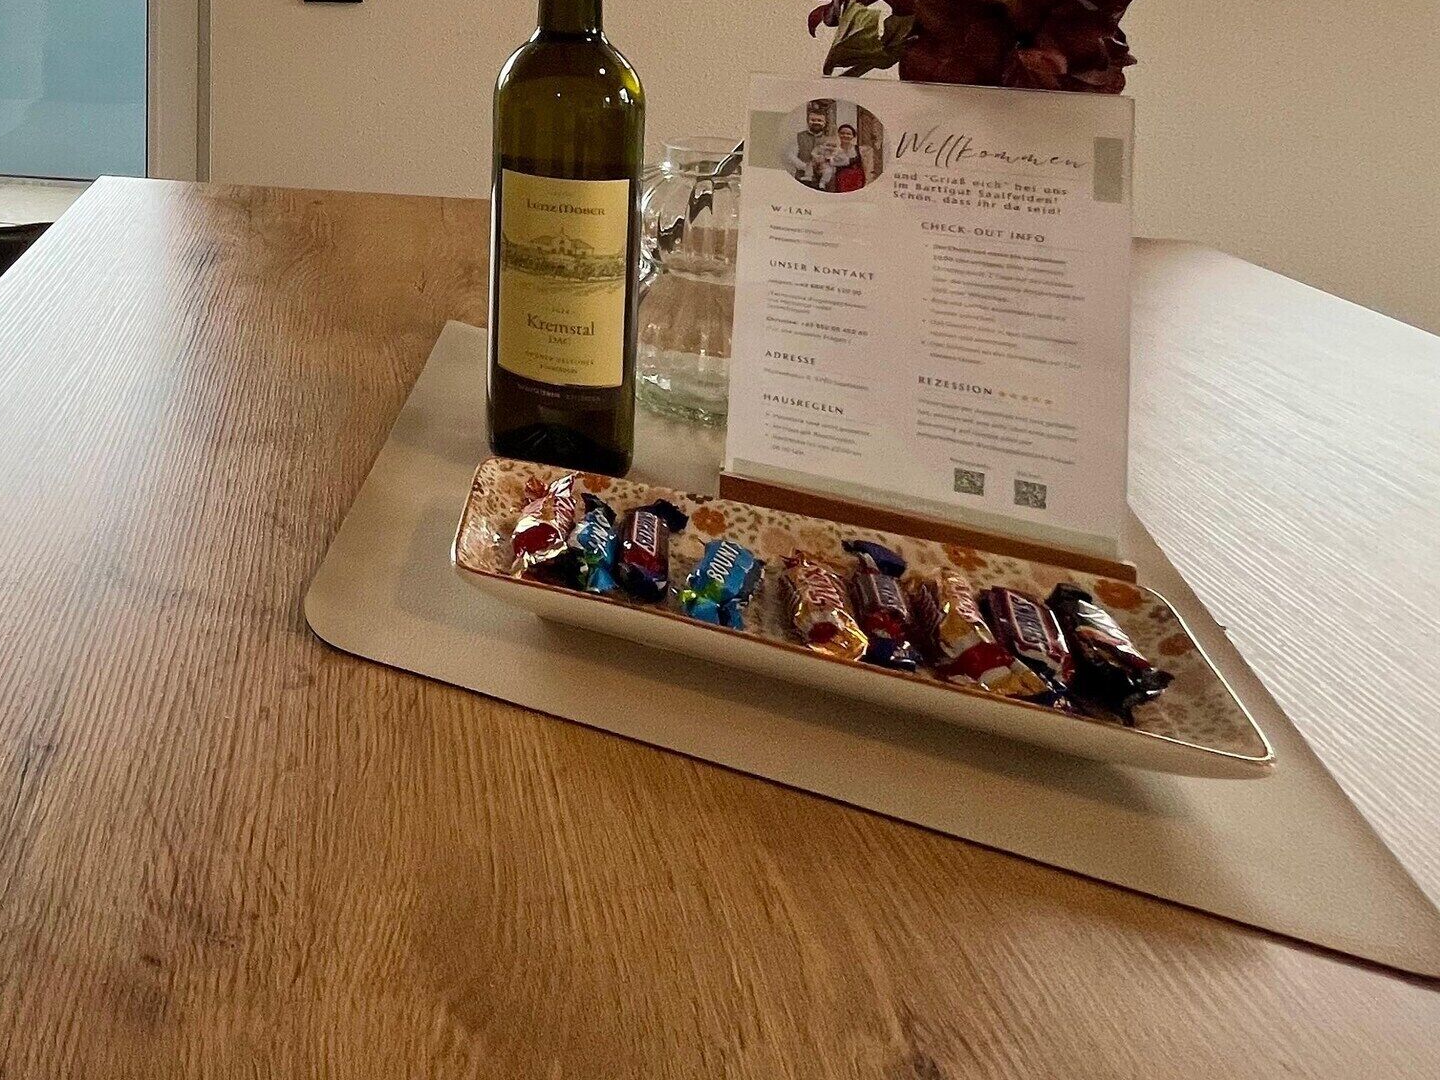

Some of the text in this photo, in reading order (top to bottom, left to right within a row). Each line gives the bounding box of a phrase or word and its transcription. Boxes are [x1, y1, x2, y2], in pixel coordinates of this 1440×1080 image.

[895, 125, 1087, 169] Willkommen
[893, 172, 918, 181] und
[1014, 183, 1037, 193] bei
[1043, 187, 1068, 196] uns
[893, 180, 909, 189] im
[942, 196, 971, 206] dass
[977, 199, 997, 208] ihr
[1003, 202, 1021, 211] da
[920, 221, 1046, 243] CHECK-OUT INFO
[769, 259, 875, 281] UNSER KONTAKT
[526, 312, 596, 336] Kremstal
[764, 350, 816, 366] ADRESSE
[917, 375, 993, 396] REZESSION
[763, 393, 844, 415] HAUSREGELN
